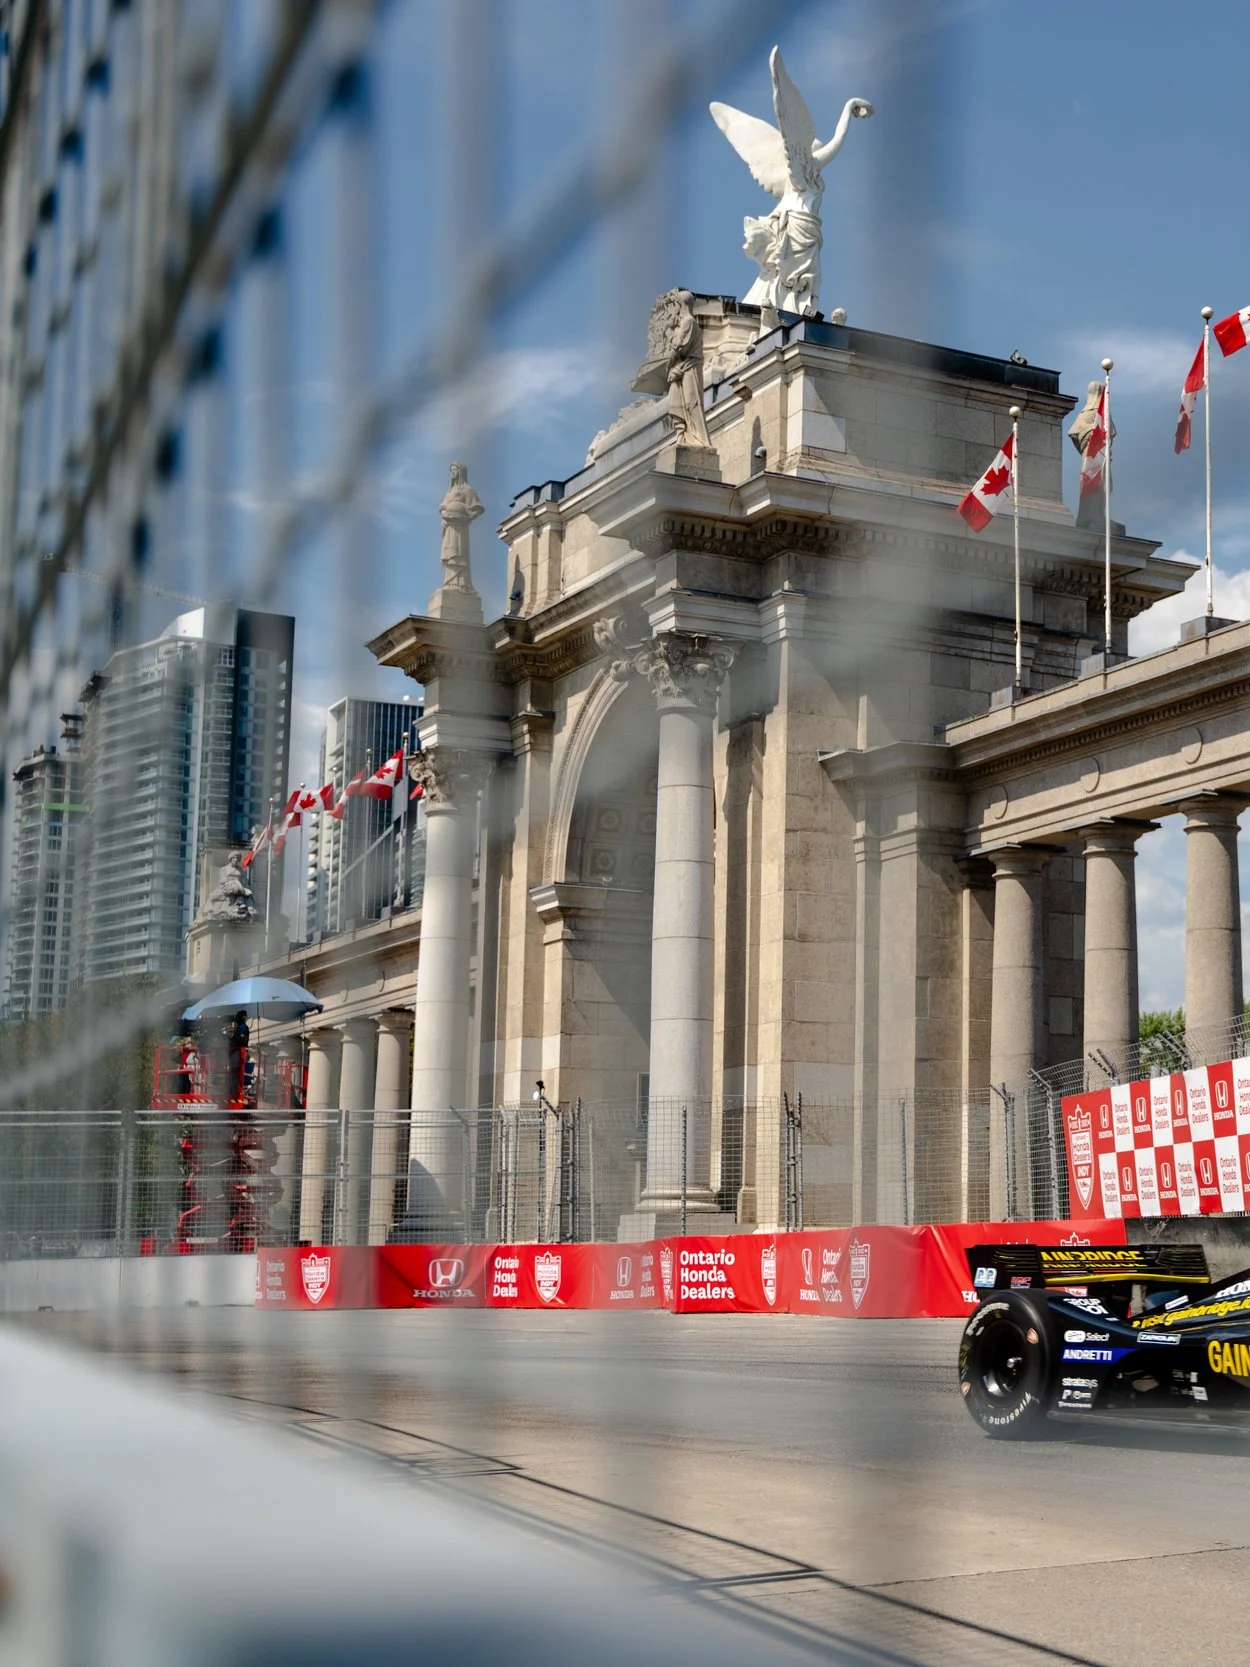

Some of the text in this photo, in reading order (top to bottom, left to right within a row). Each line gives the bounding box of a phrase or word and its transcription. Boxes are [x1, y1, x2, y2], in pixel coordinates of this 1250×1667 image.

[1190, 1085, 1206, 1099] Ontario
[1192, 1099, 1206, 1110] Honda
[1192, 1111, 1209, 1124] Dealers
[680, 1248, 735, 1265] Ontario
[680, 1265, 726, 1283] Honda
[413, 1288, 475, 1299] HONDA
[681, 1283, 736, 1299] Dealers
[1085, 1332, 1110, 1341] Select
[1062, 1349, 1112, 1361] ANDRETTI
